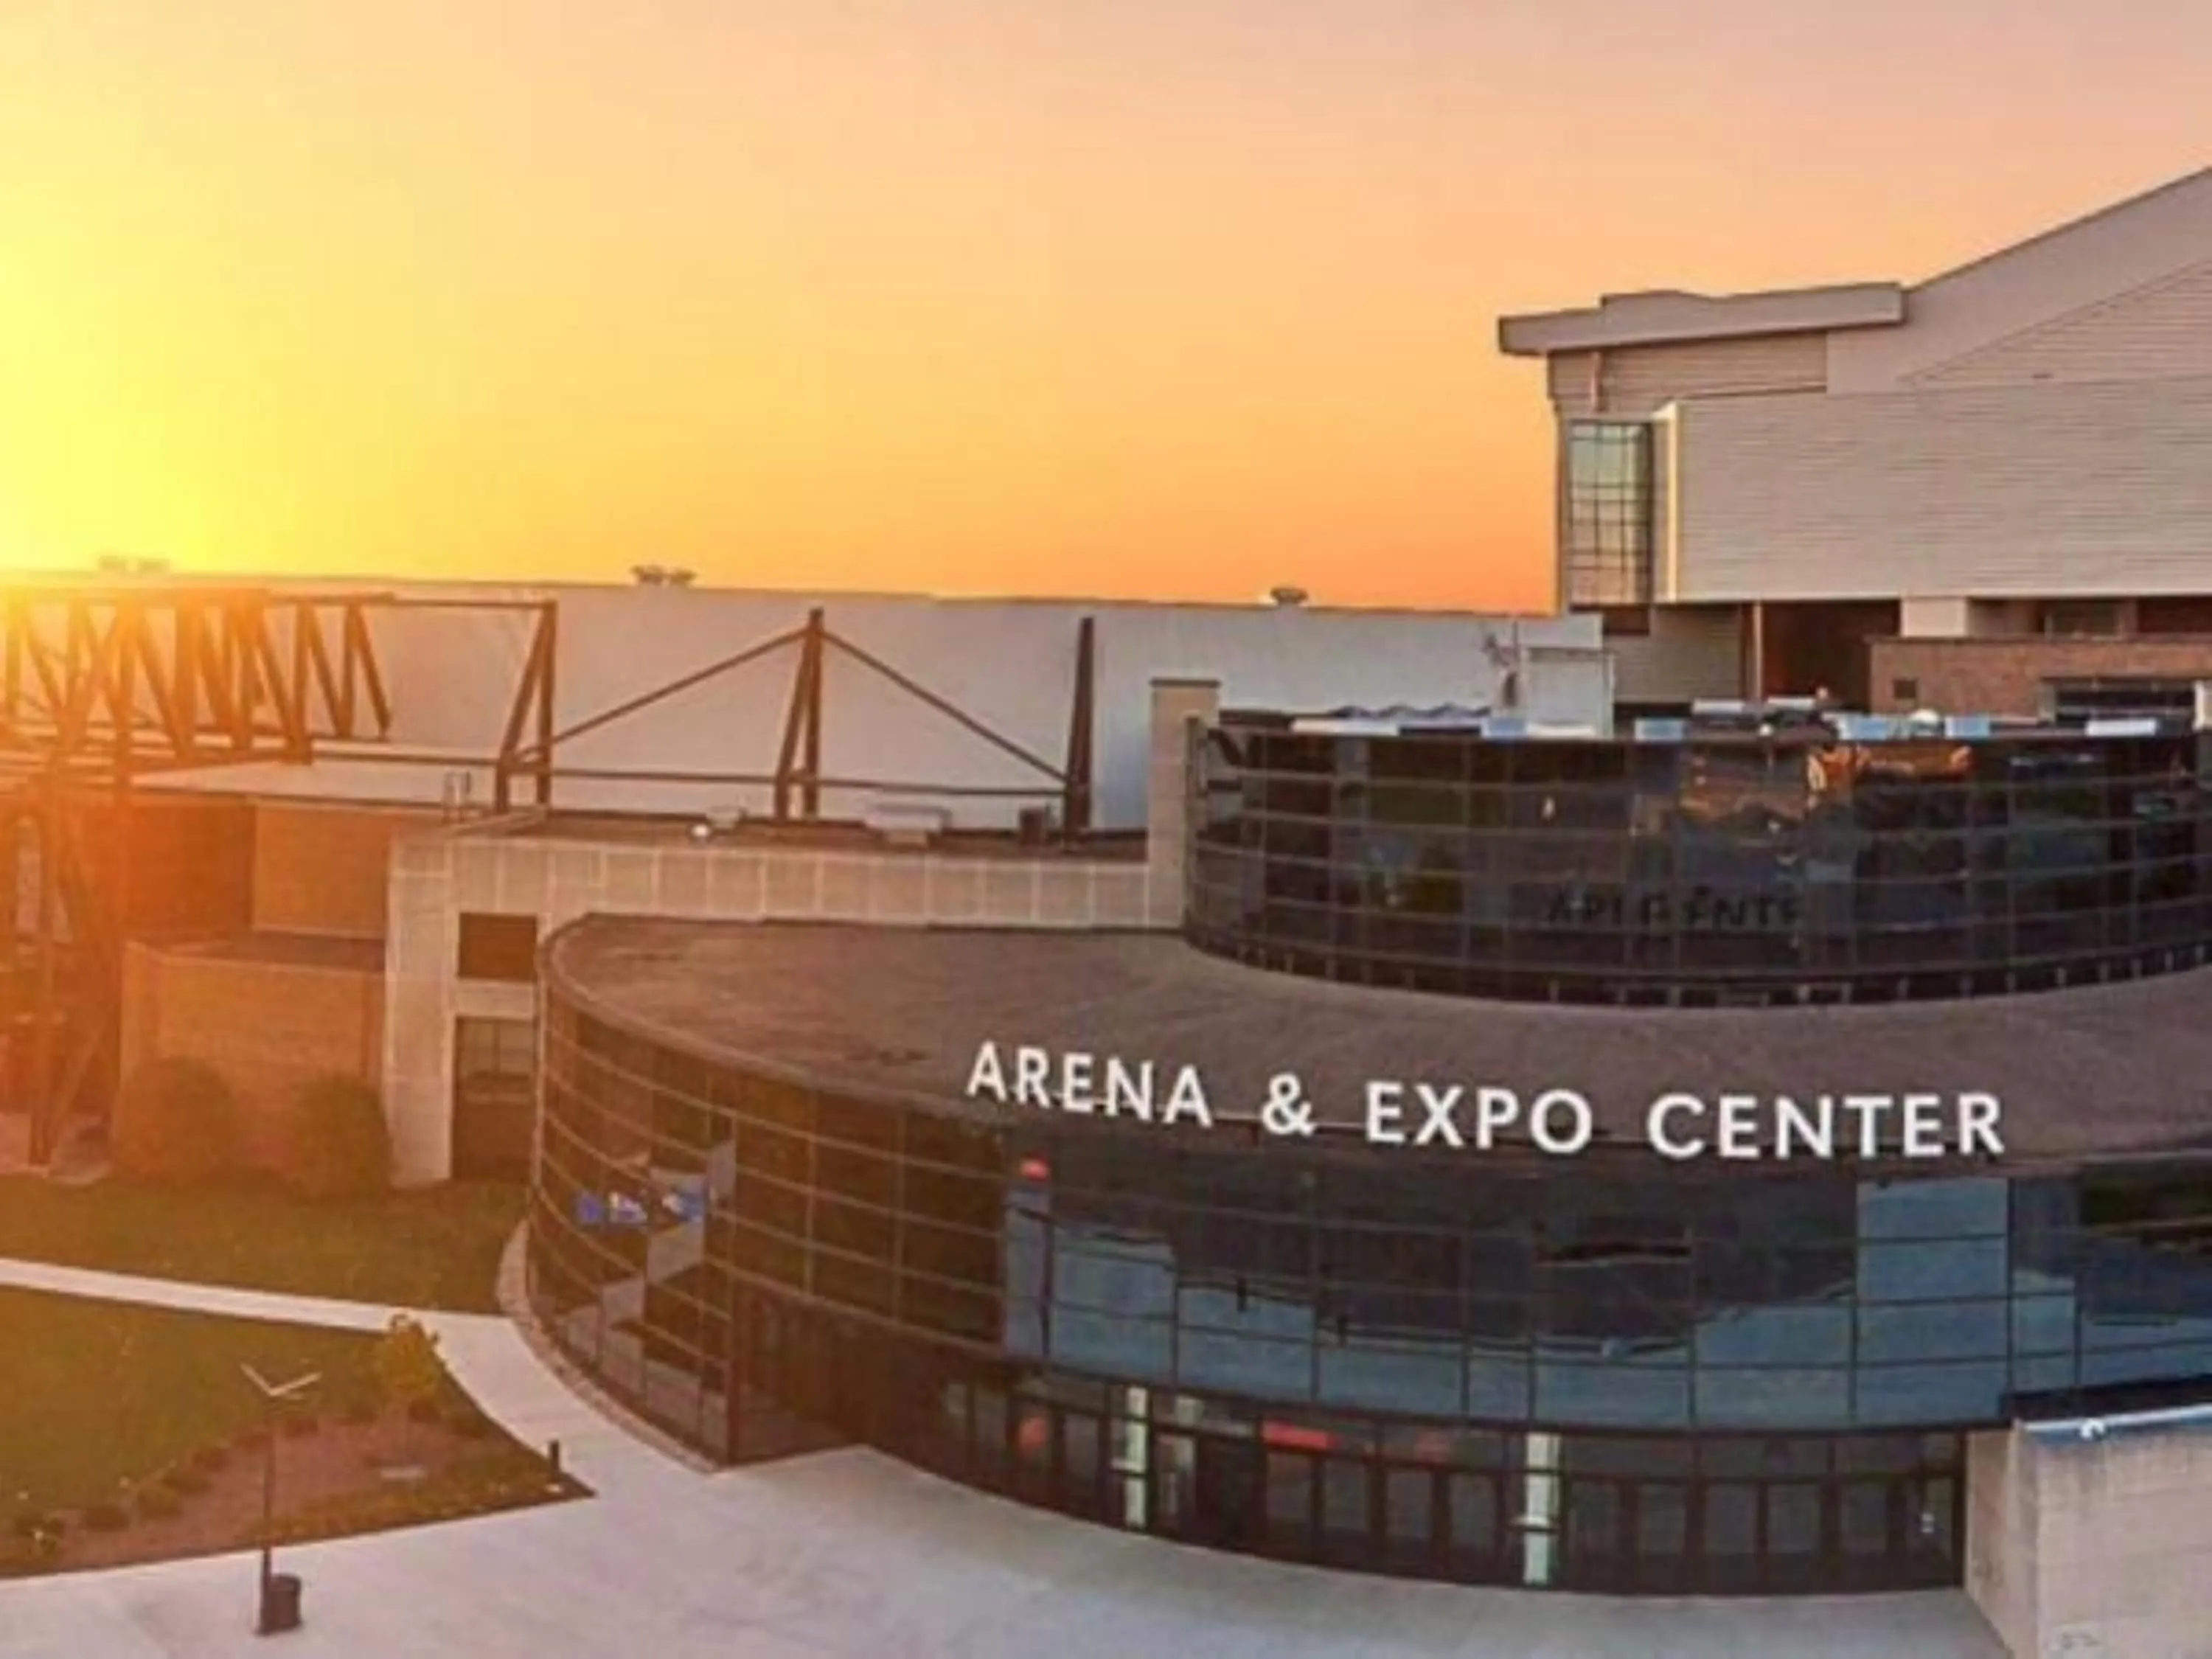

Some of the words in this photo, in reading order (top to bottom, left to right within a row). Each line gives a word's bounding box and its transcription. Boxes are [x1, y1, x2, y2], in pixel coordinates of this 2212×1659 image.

[966, 1040, 1212, 1127] ARENA
[1261, 1073, 1316, 1135] &
[1366, 1081, 1593, 1153] EXPO
[1647, 1092, 2005, 1158] CENTER
